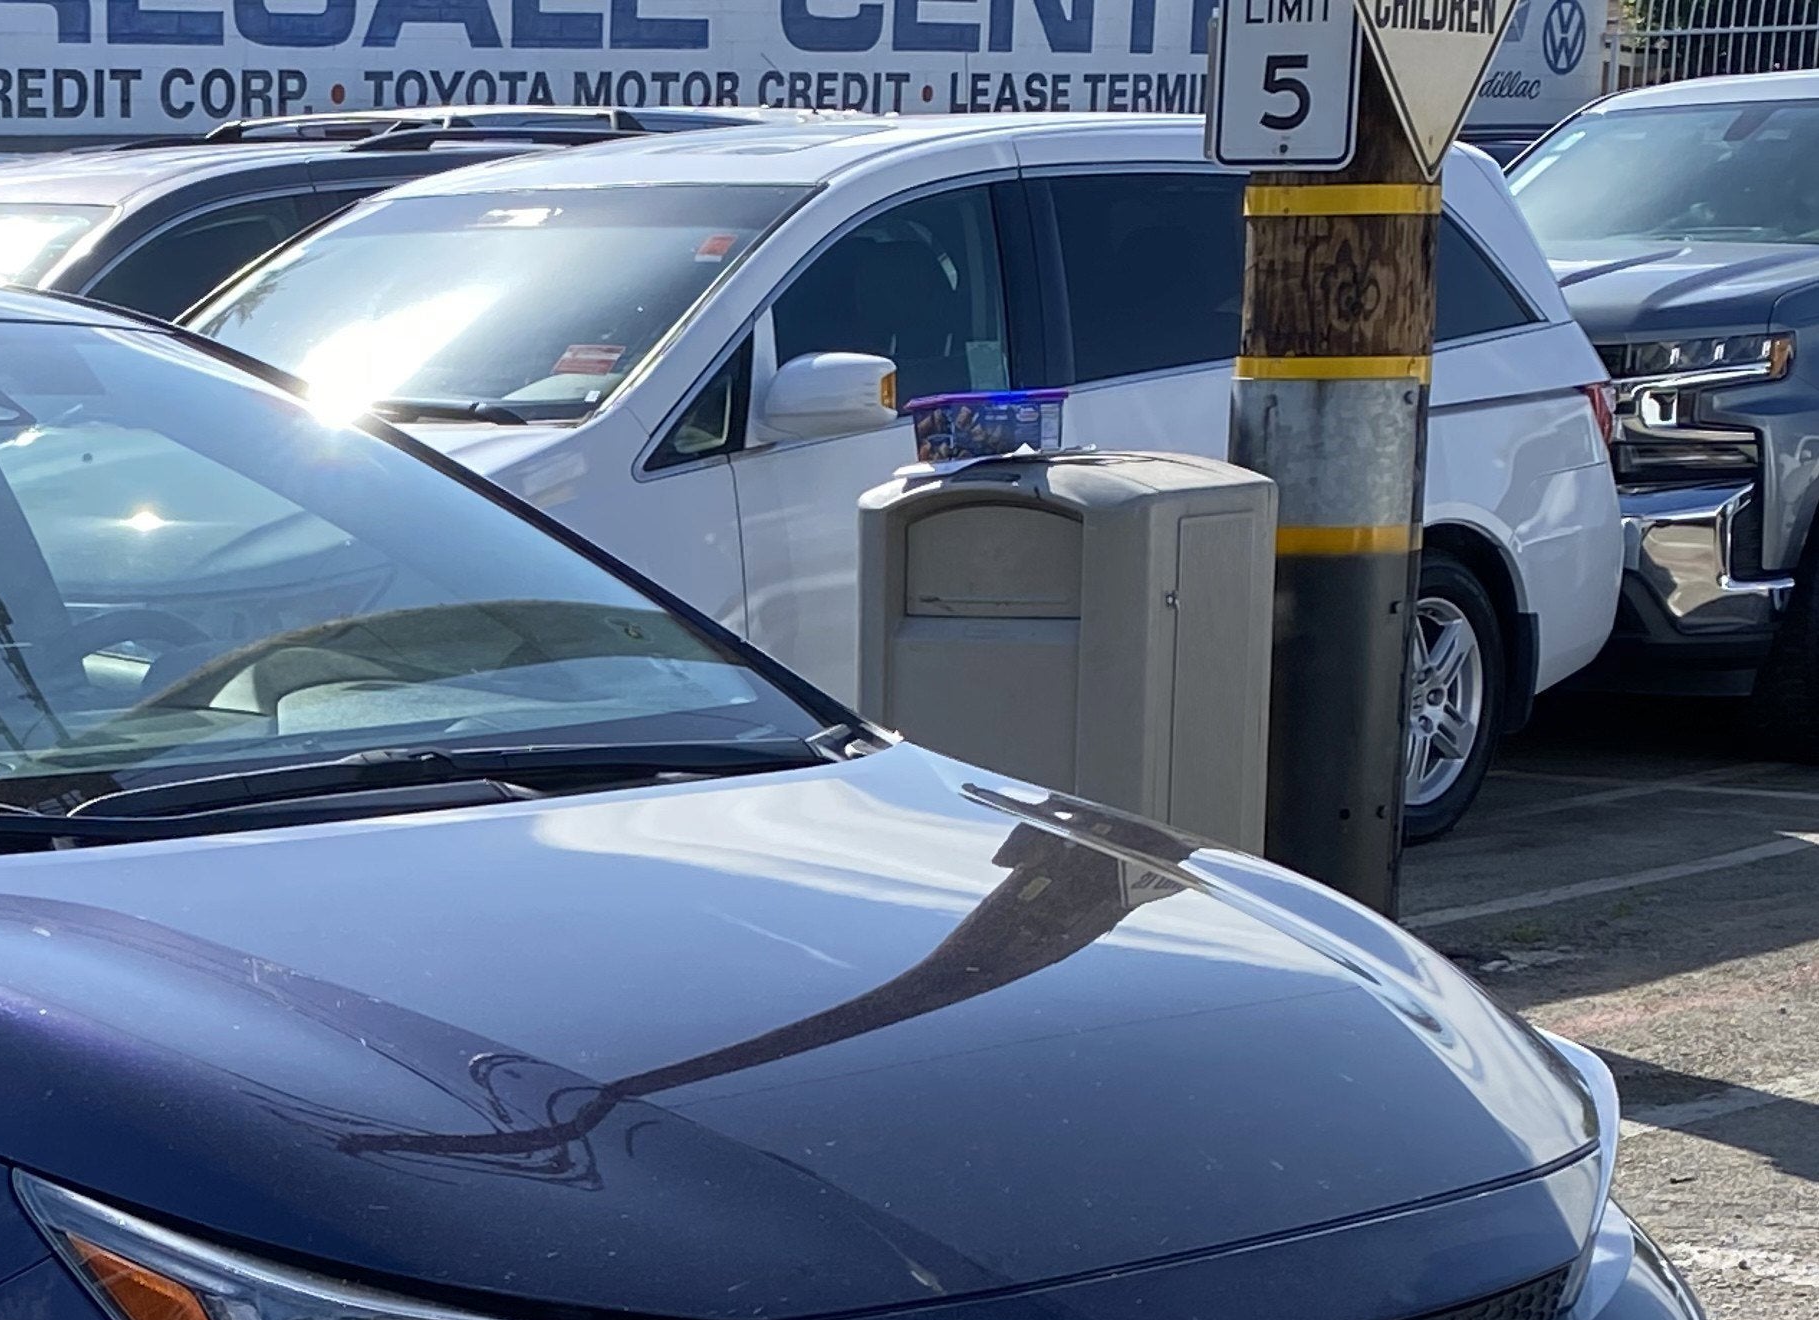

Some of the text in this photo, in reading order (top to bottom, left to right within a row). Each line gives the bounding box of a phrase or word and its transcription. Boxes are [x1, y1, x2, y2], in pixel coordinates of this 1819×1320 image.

[160, 67, 313, 119] CORP.
[363, 69, 554, 106] TOYOTA
[572, 70, 740, 108] MOTOR
[758, 70, 911, 114] CREDIT
[949, 71, 1070, 114] LEASE
[1259, 55, 1311, 130] 5
[1478, 71, 1541, 99] dillac
